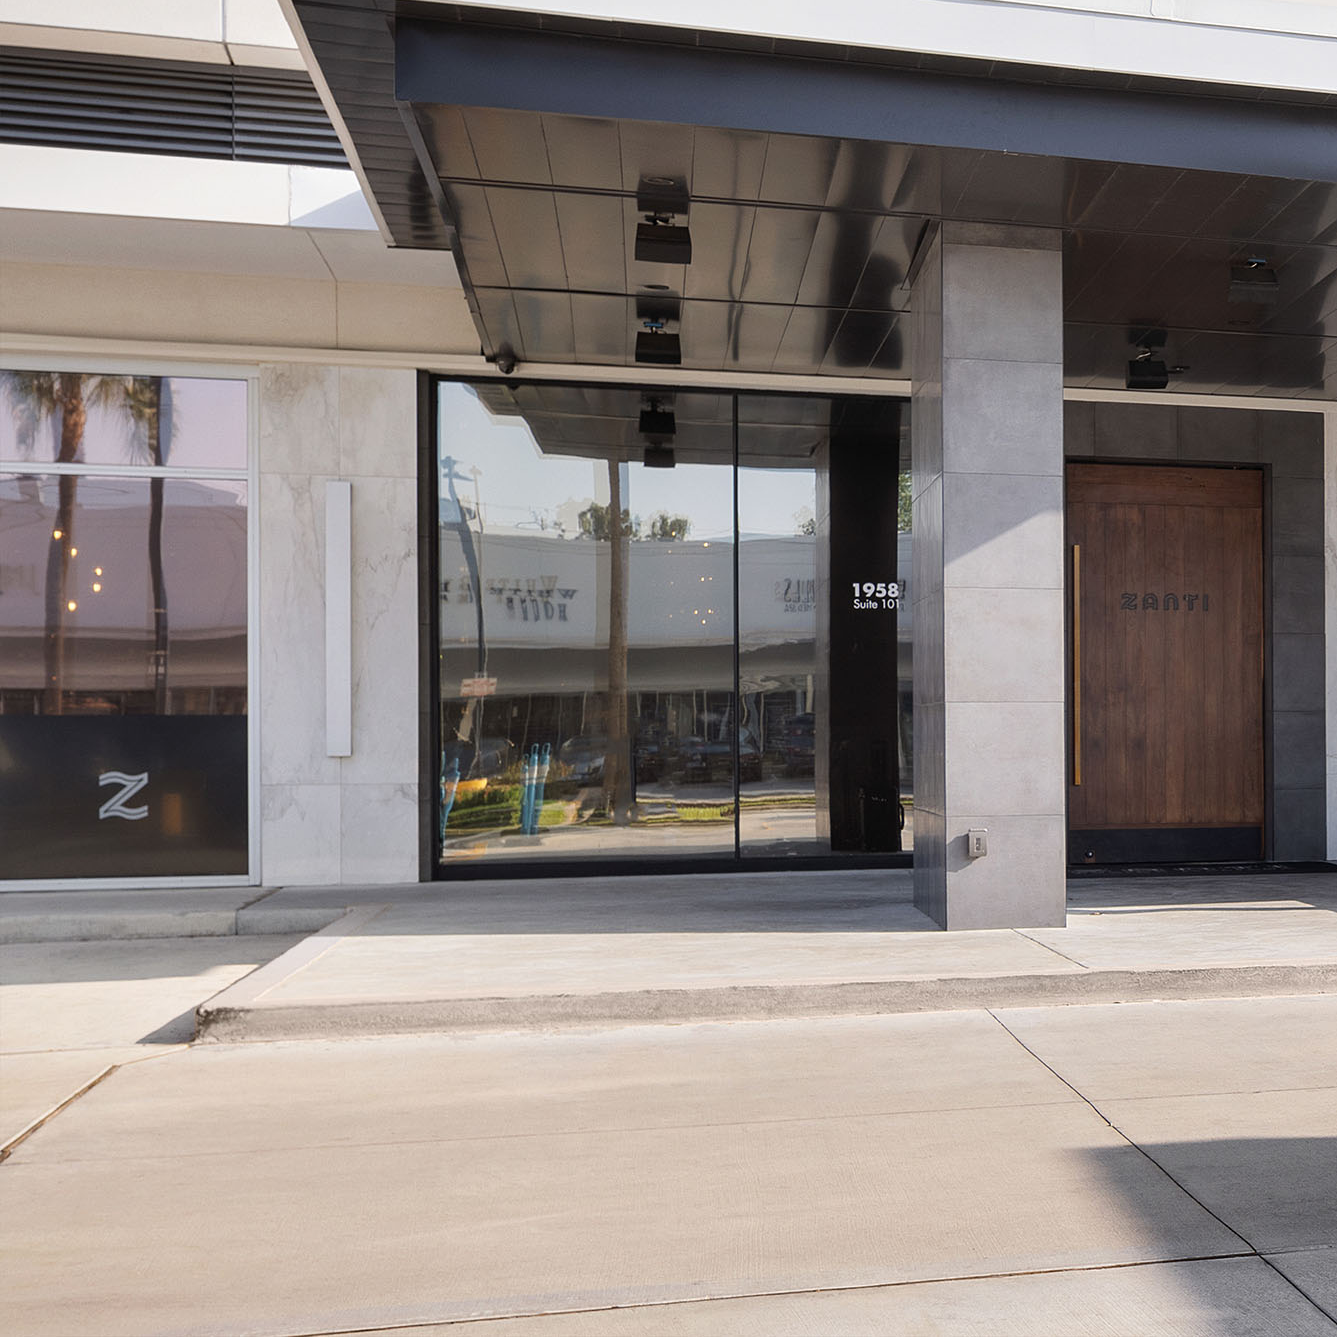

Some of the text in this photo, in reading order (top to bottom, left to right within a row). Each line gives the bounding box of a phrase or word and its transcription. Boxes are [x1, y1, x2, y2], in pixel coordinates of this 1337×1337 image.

[852, 582, 900, 598] 1958
[853, 598, 900, 610] Suite 101
[1120, 592, 1209, 612] ZANTI
[98, 770, 149, 820] Z
